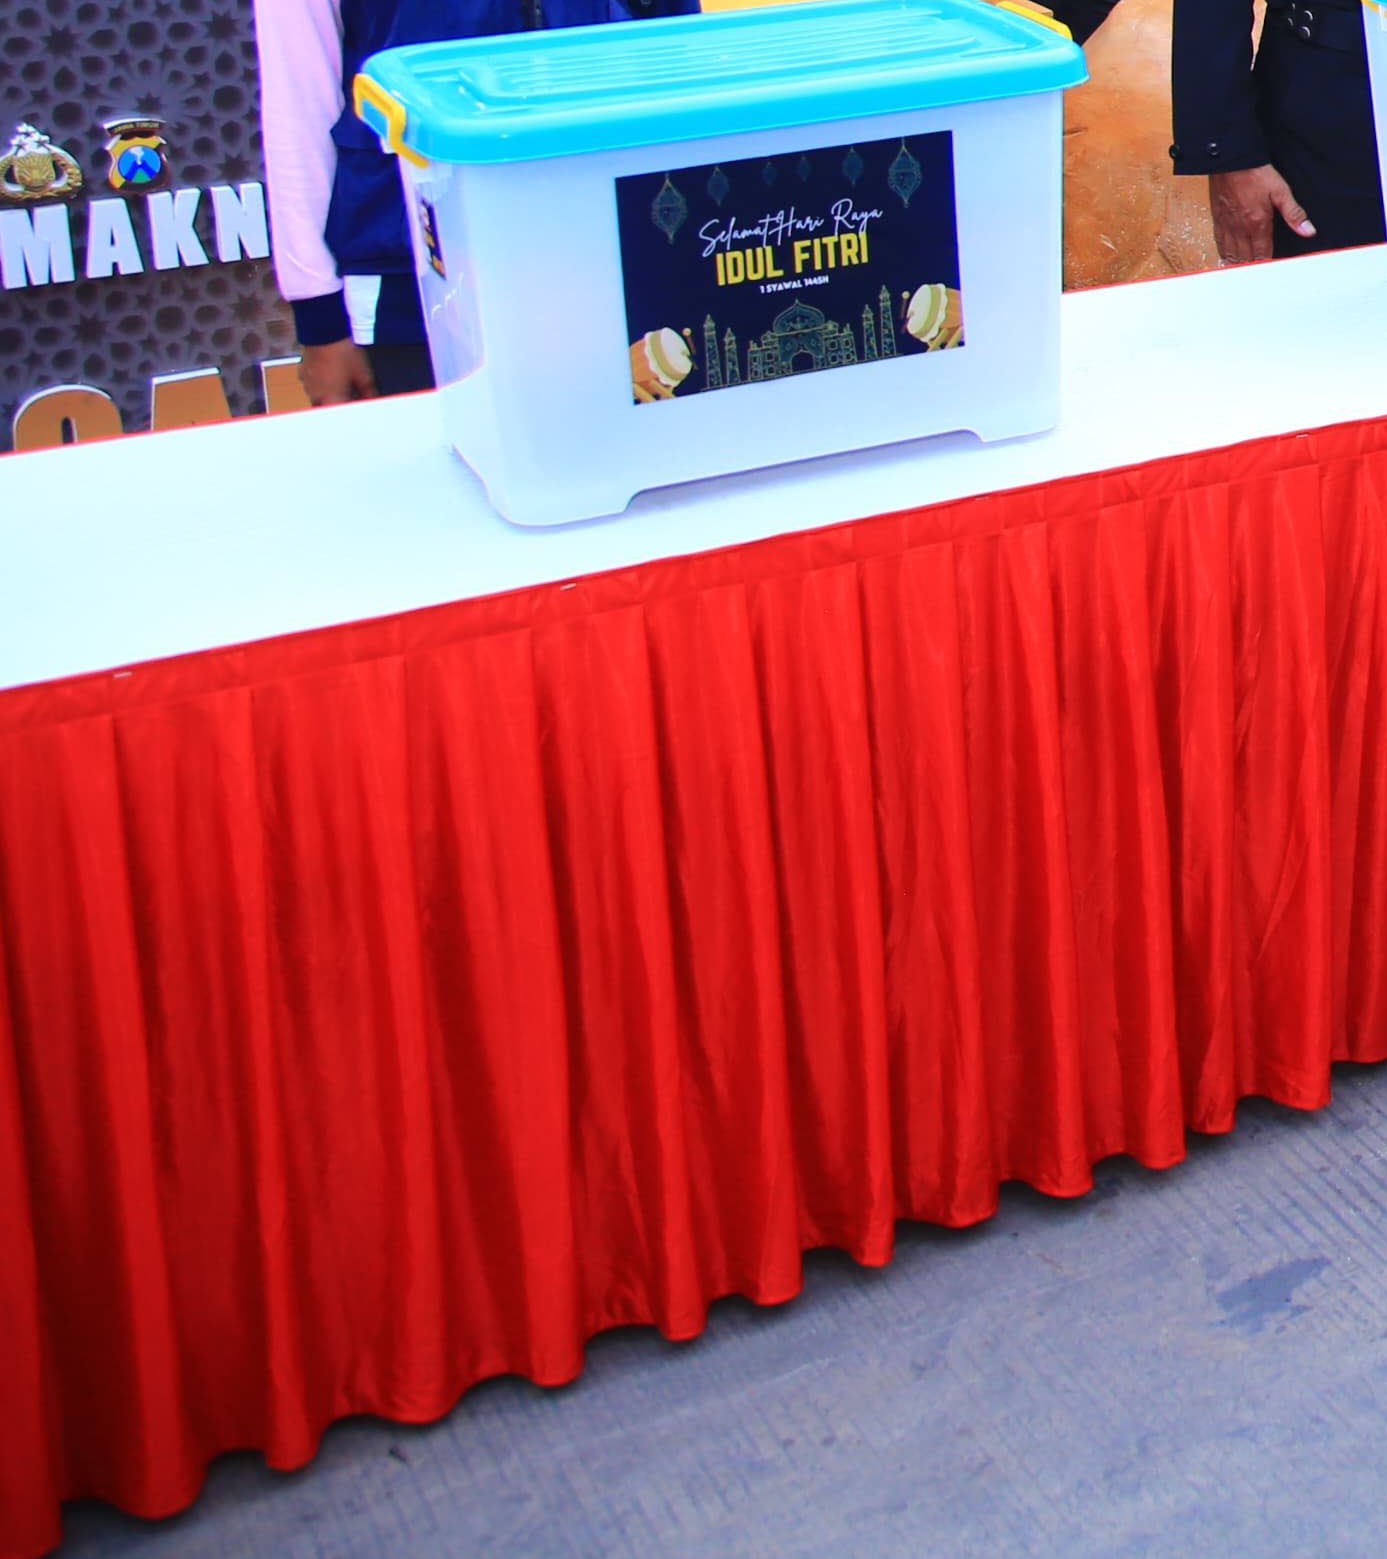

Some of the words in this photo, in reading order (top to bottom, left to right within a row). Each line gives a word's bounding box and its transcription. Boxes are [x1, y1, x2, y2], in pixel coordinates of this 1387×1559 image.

[699, 213, 777, 258] Selamat
[768, 206, 825, 246] Hari
[830, 198, 884, 238] Raya
[715, 245, 785, 286] IDUL
[793, 231, 869, 273] FITRI
[766, 280, 803, 293] SYAWAL
